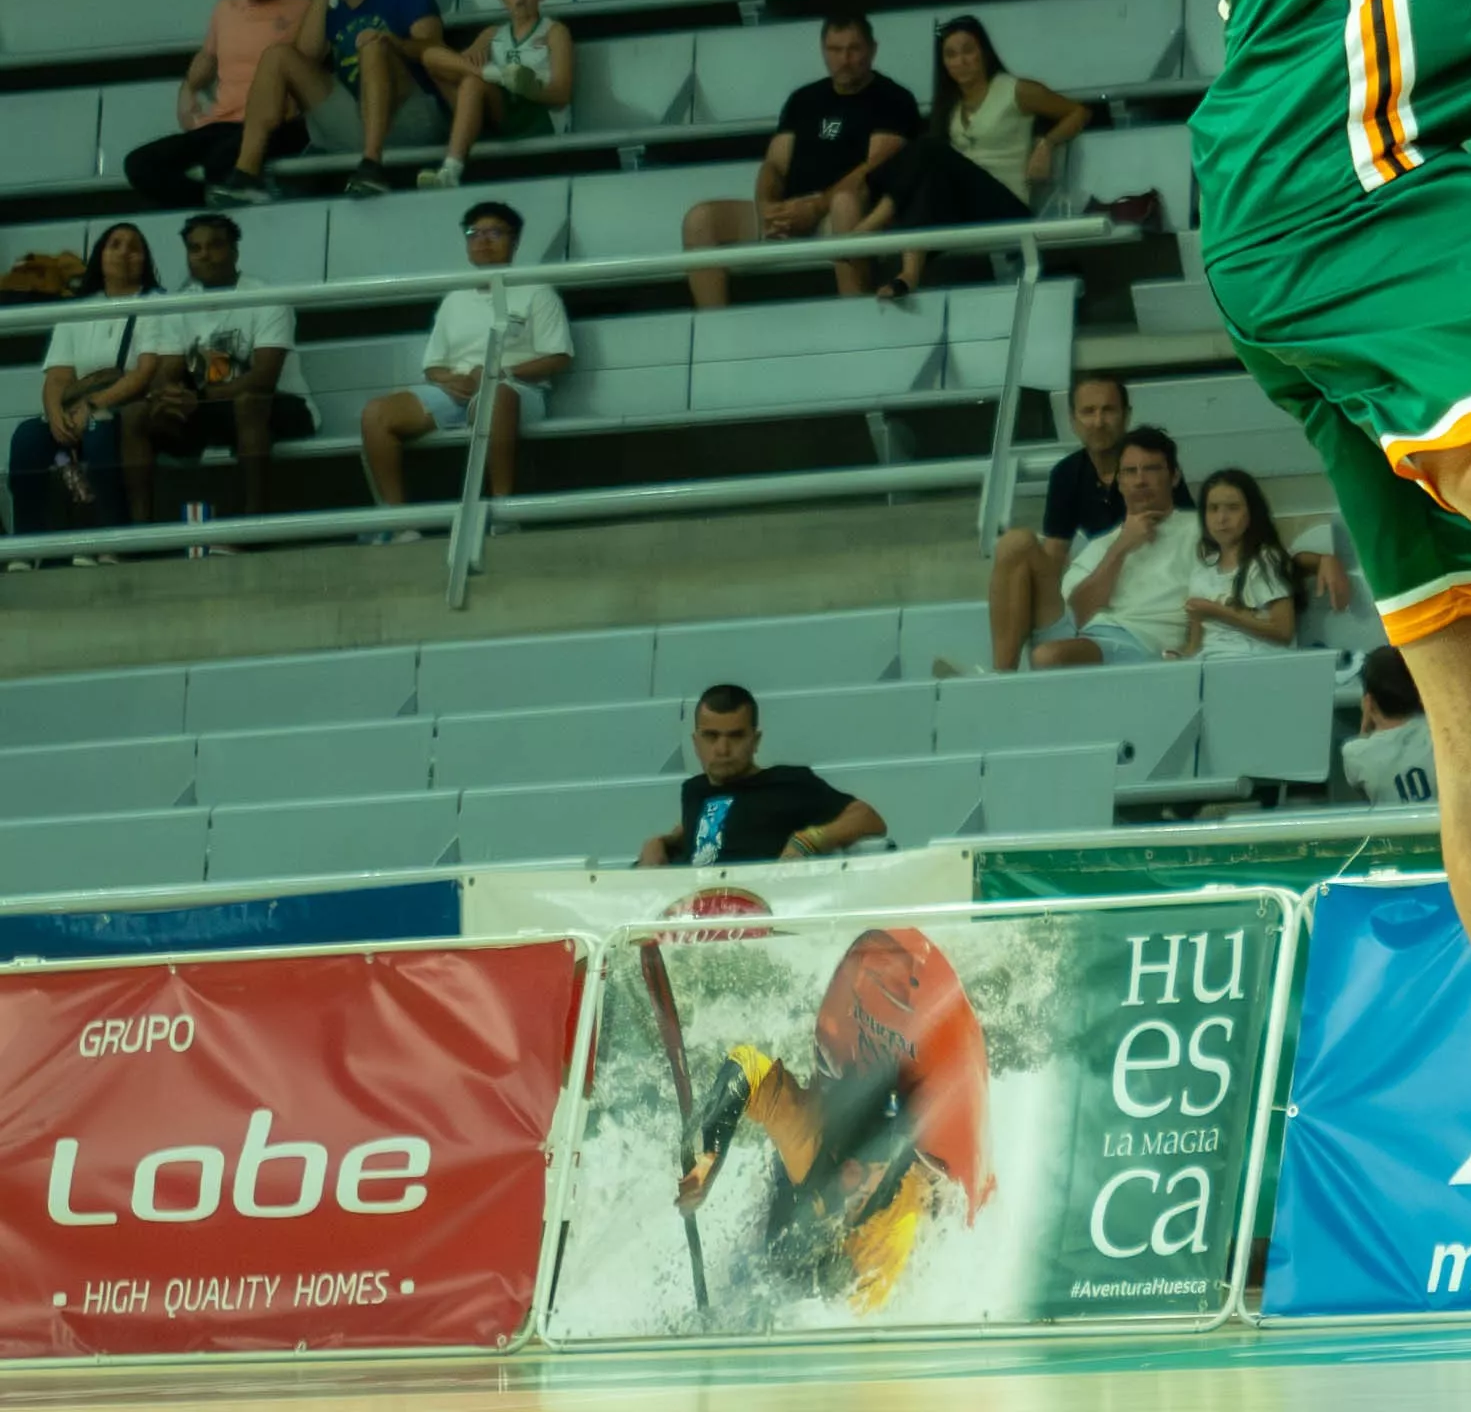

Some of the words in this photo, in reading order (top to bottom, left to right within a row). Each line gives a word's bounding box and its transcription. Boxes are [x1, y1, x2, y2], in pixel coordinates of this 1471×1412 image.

[1121, 928, 1244, 1006] Hu
[79, 1014, 195, 1058] GRUPO
[1112, 1016, 1234, 1118] es
[48, 1107, 431, 1226] Lobe
[1090, 1166, 1211, 1259] ca
[83, 1280, 150, 1314] HIGH
[164, 1275, 280, 1319] QUALITY
[294, 1270, 389, 1307] HOMES
[1070, 1278, 1207, 1299] #AventuraHuesca
